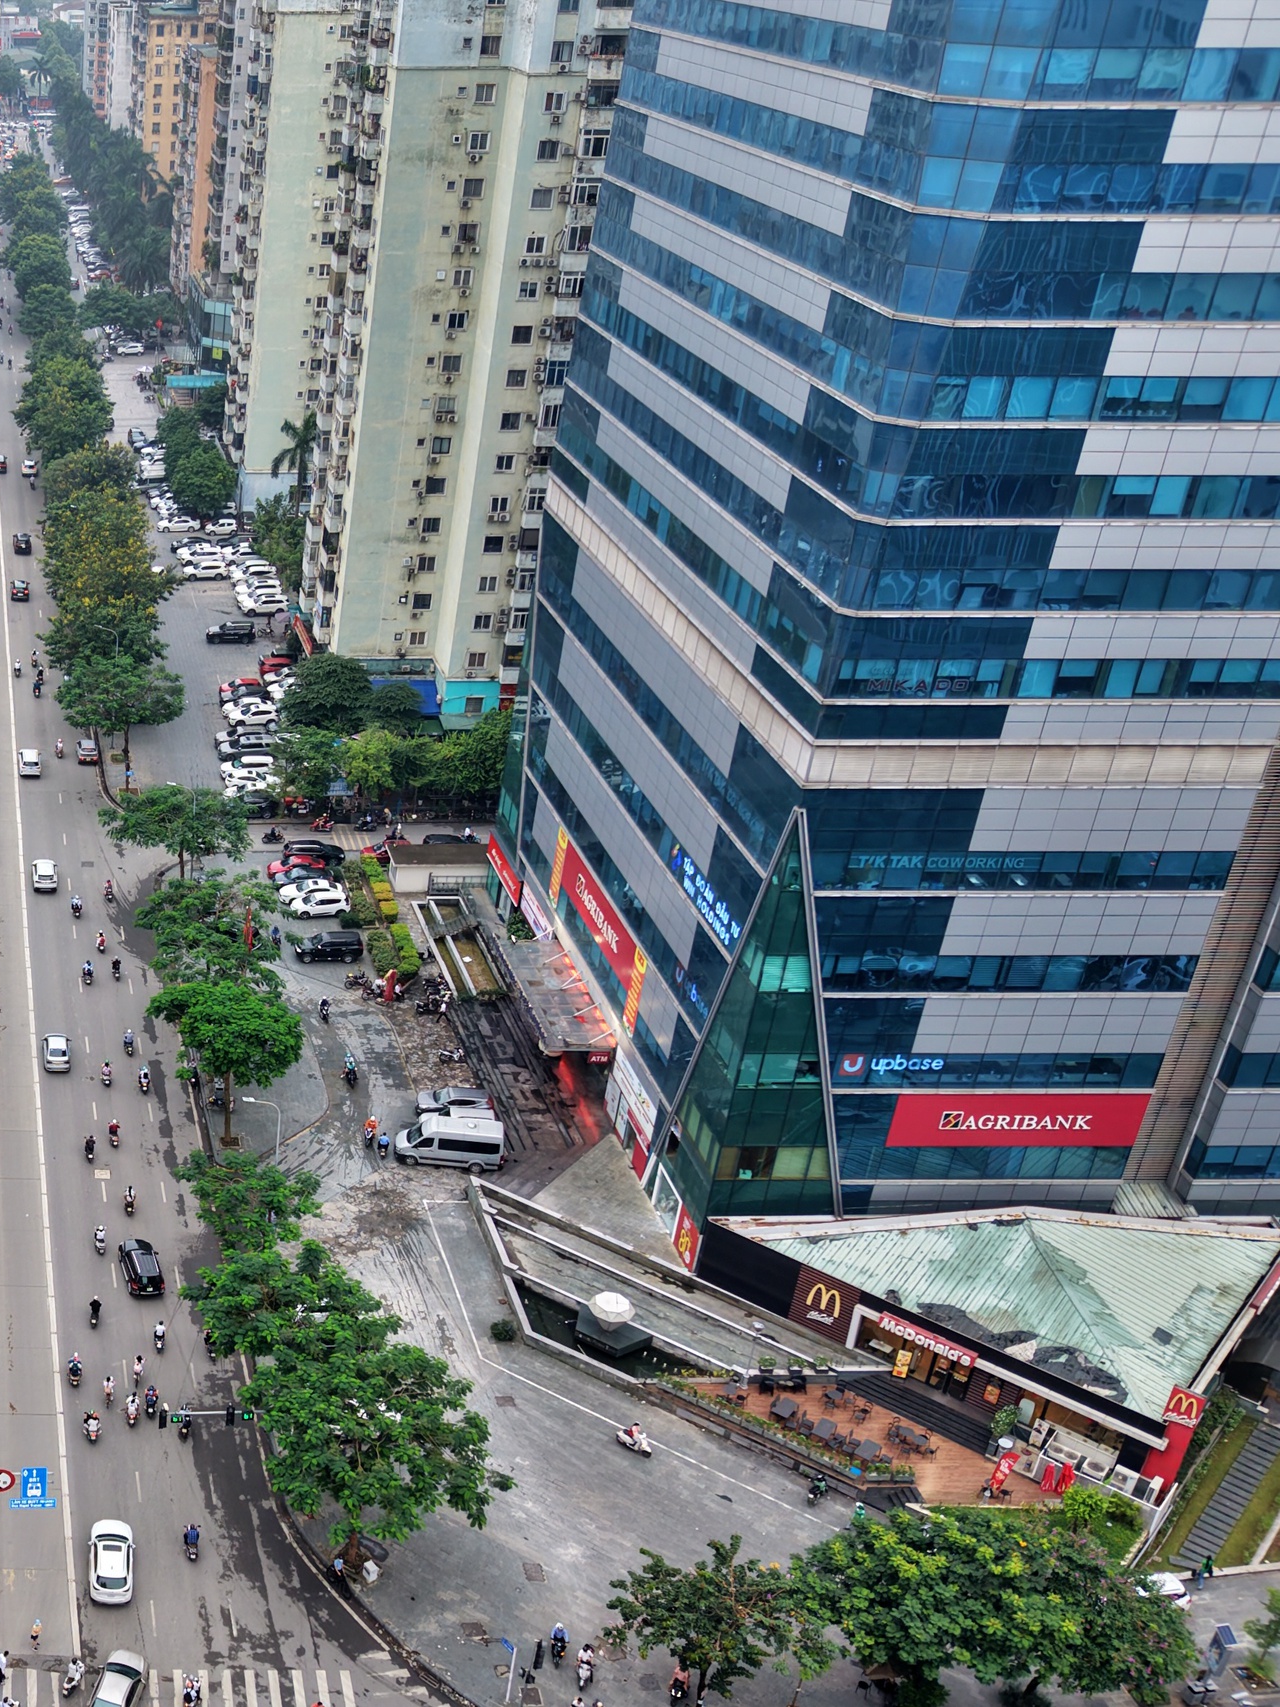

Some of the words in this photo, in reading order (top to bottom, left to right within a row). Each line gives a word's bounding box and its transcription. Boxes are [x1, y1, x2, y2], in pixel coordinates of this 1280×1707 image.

[867, 678, 970, 692] MIKADO
[858, 855, 888, 869] TIK
[890, 855, 925, 869] TAK
[926, 857, 1026, 869] COWORKING
[581, 888, 620, 954] AGRIBANK
[696, 895, 730, 946] HOLDINGS
[870, 1054, 945, 1076] upbase
[961, 1114, 1093, 1131] AGRIBANK
[879, 1317, 972, 1368] McDonald's
